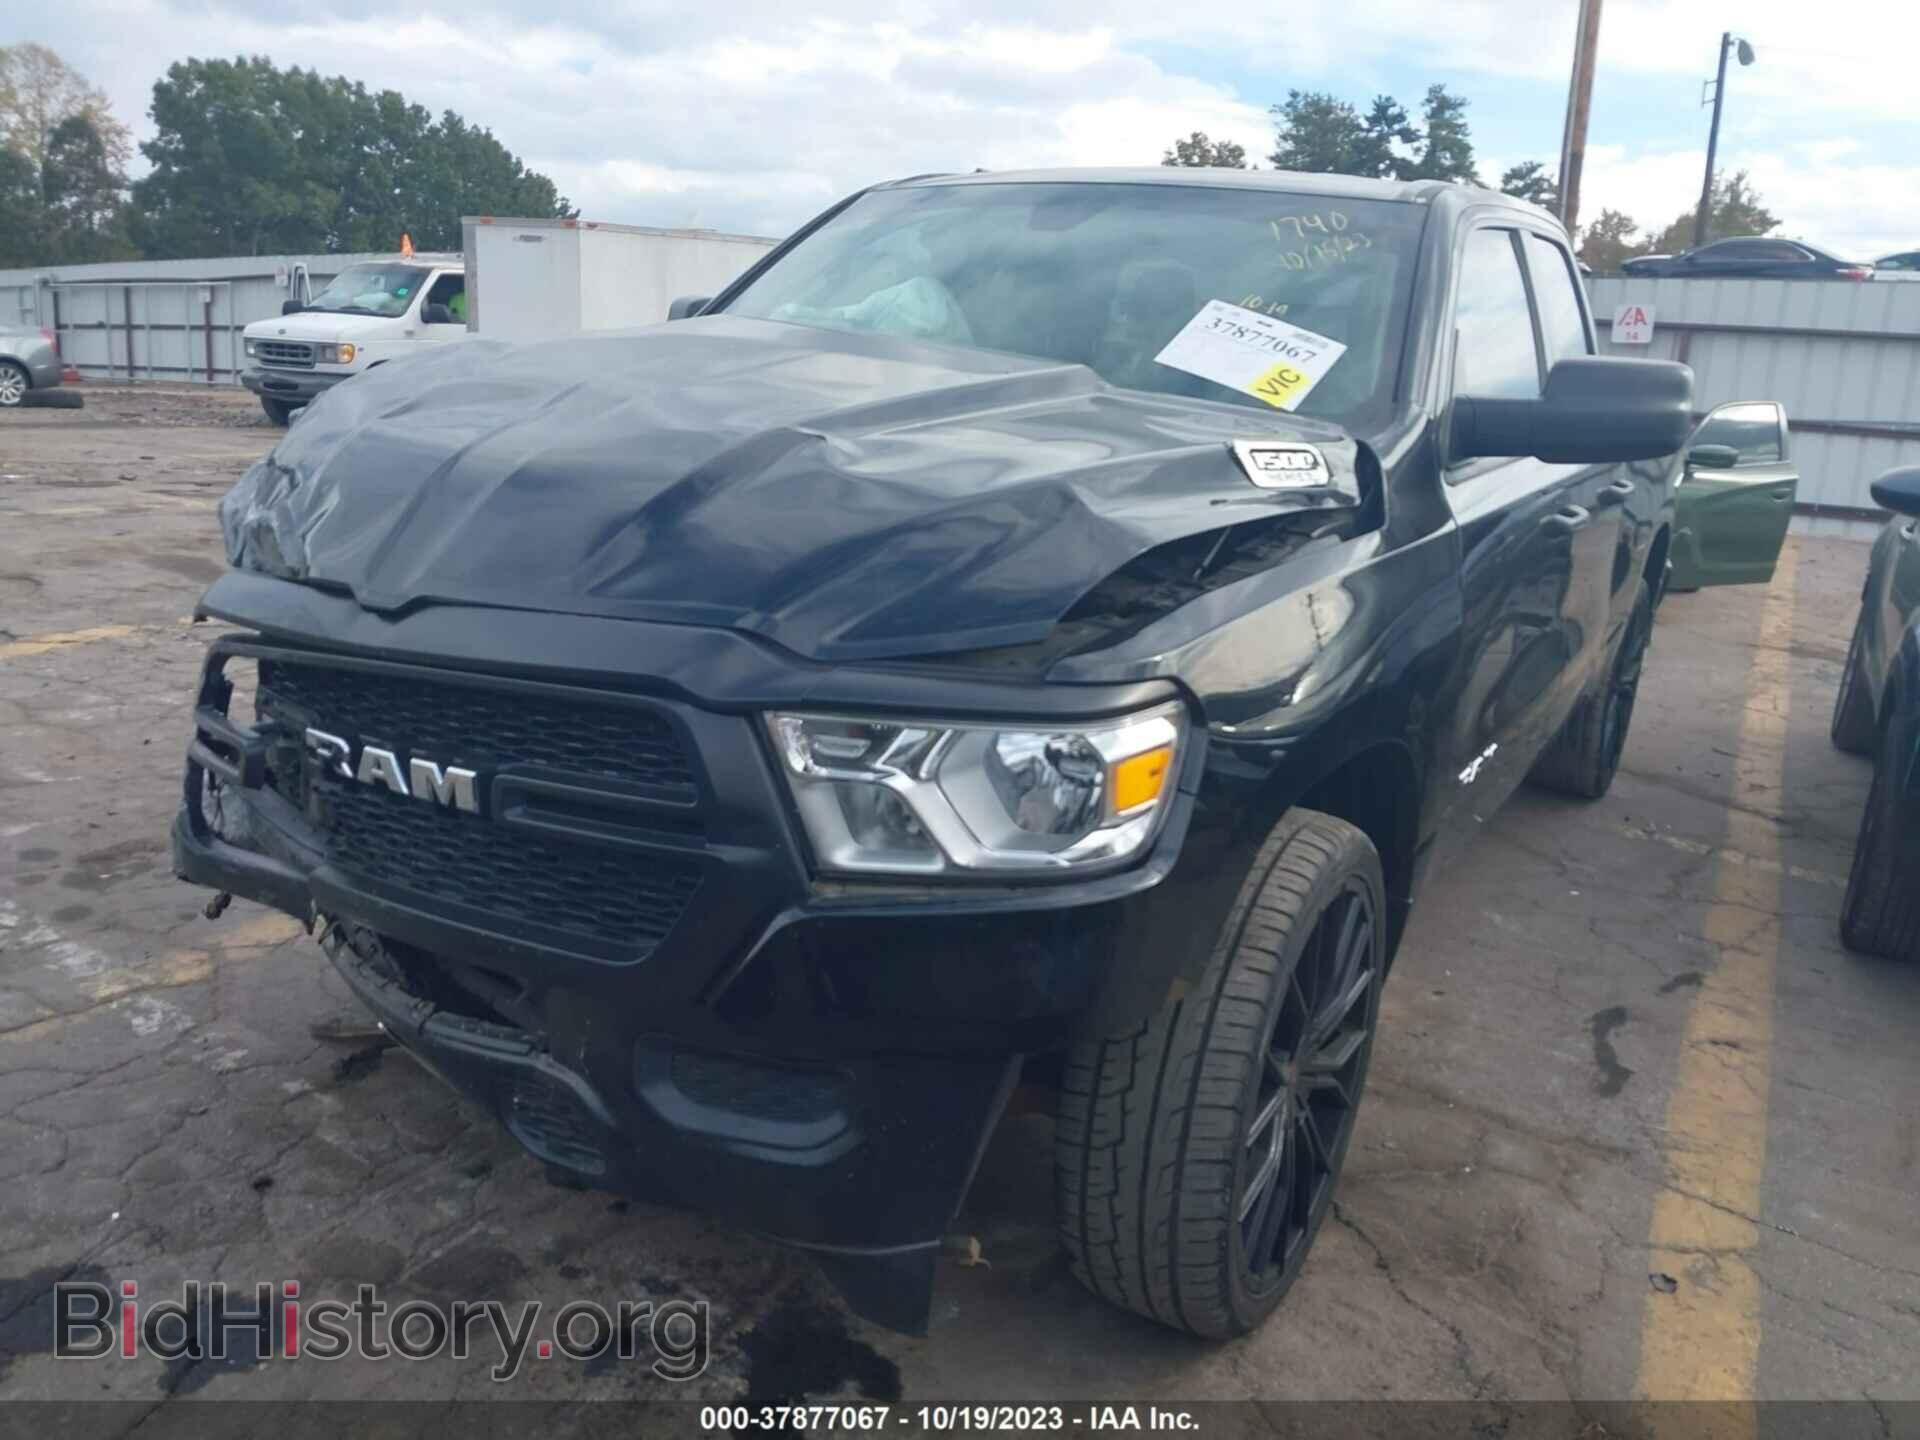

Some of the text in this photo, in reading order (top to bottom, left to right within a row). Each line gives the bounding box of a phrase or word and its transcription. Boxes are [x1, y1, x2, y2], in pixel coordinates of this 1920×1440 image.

[1269, 209, 1349, 241] 1740
[1203, 316, 1318, 364] 37877067
[1256, 368, 1301, 399] VIC
[305, 727, 480, 813] RAM
